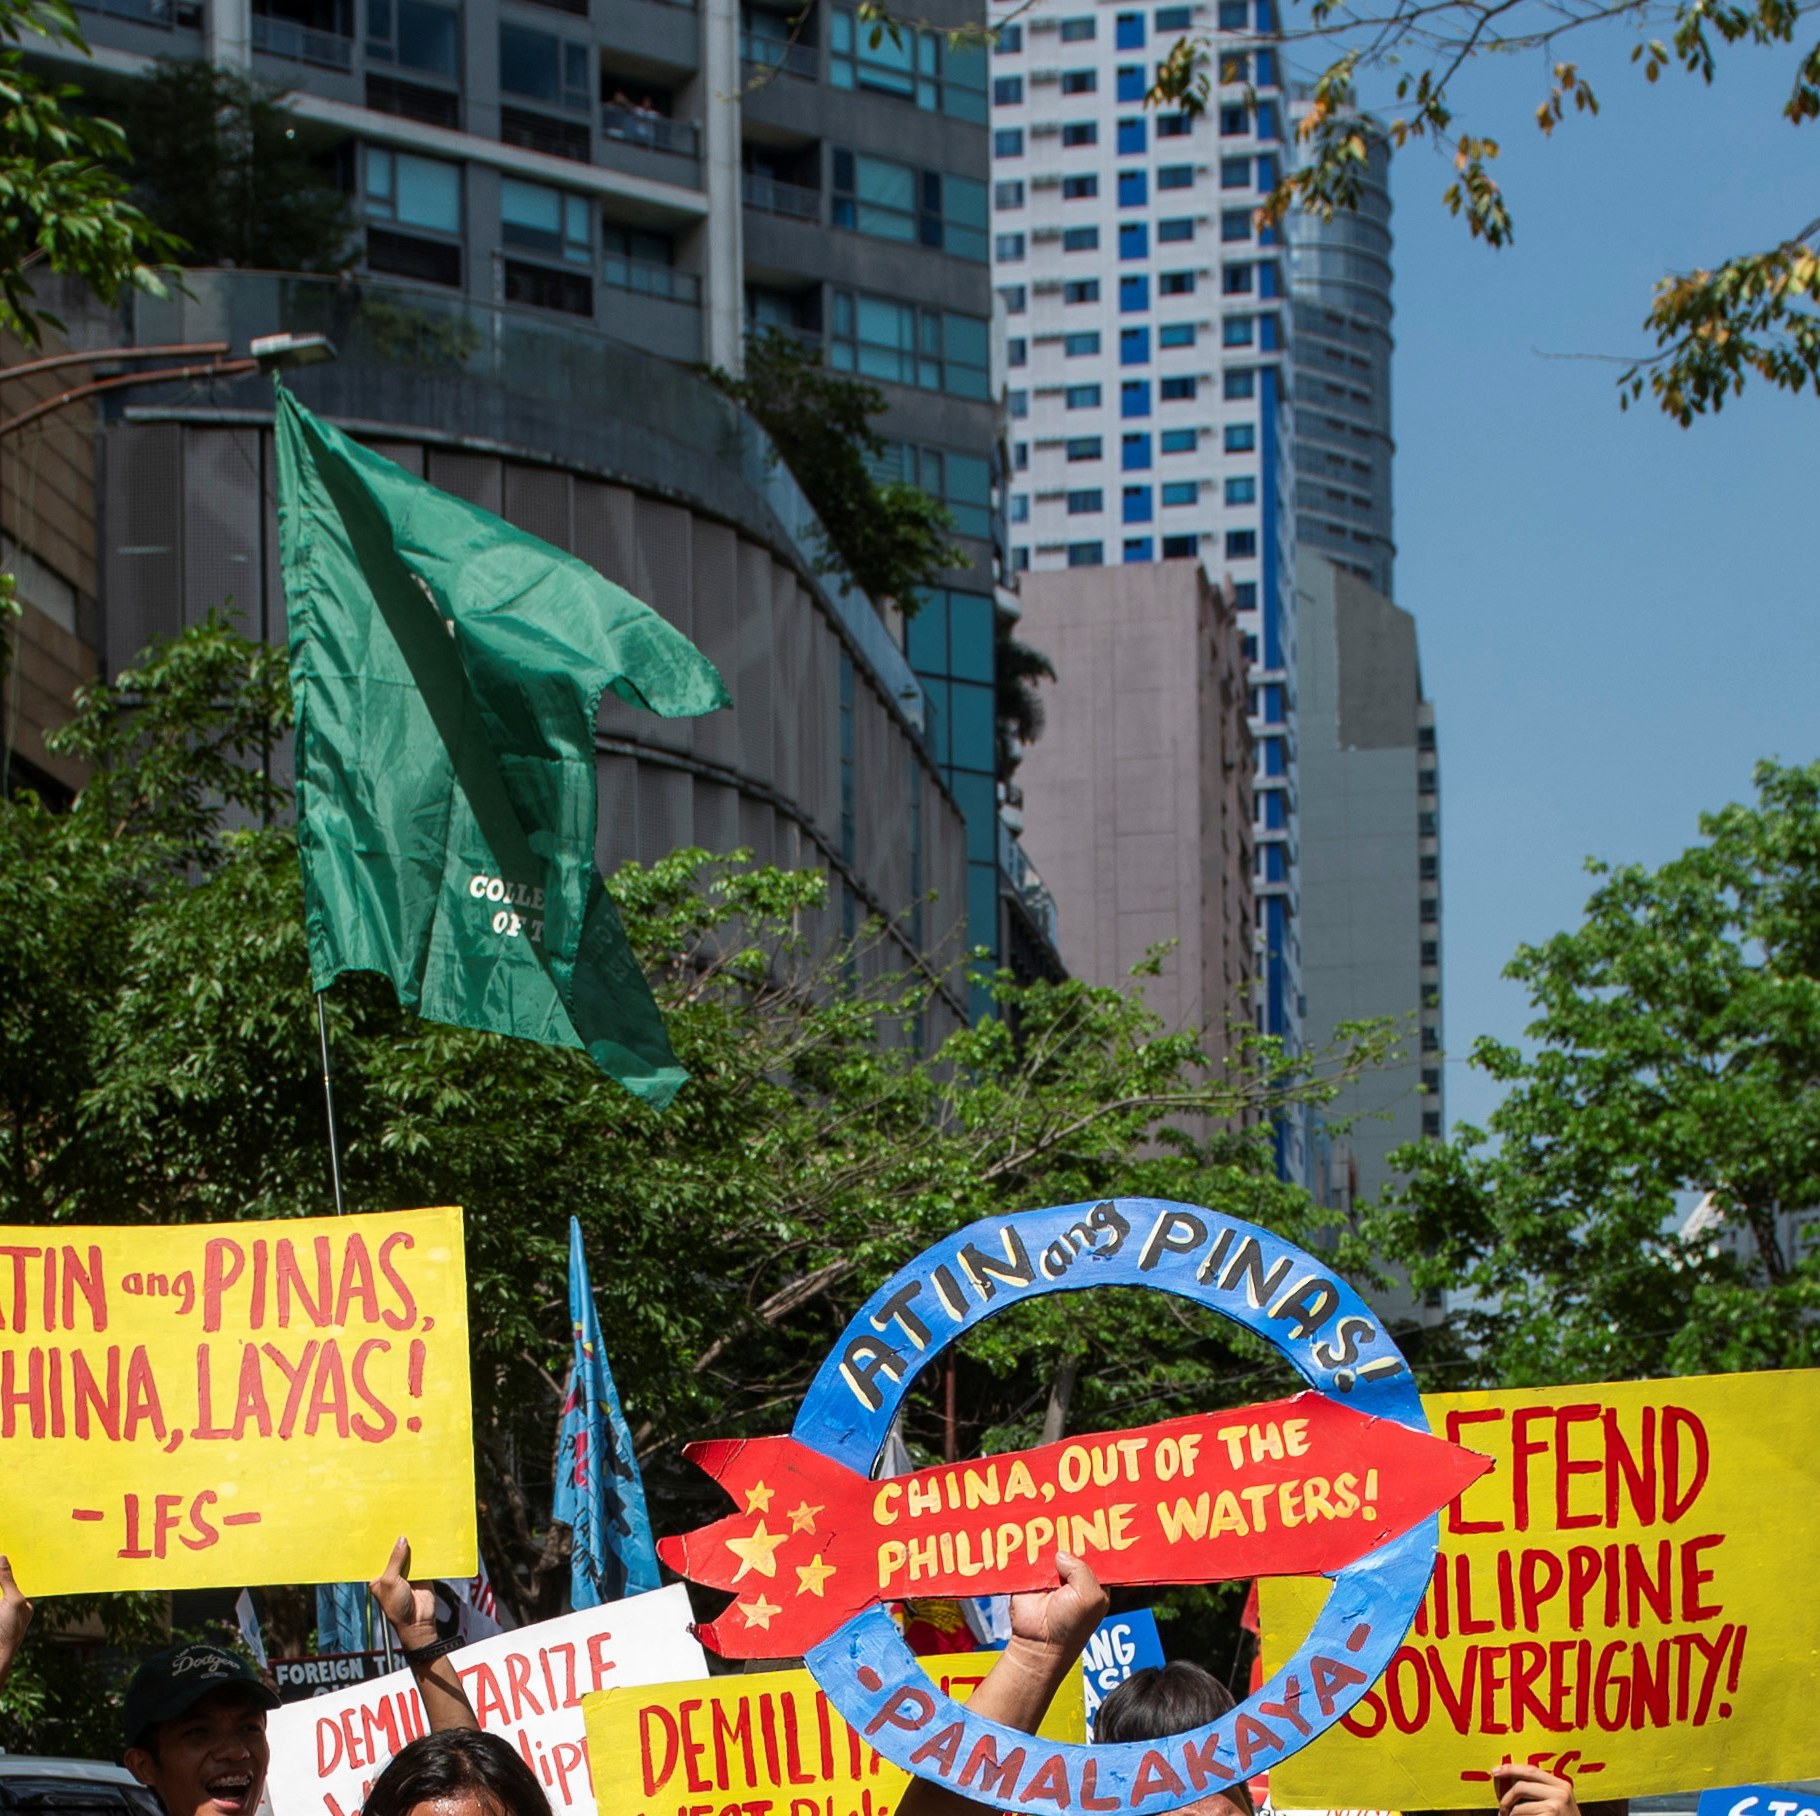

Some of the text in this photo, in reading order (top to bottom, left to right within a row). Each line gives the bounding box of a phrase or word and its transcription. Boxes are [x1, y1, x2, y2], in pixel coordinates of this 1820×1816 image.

[122, 1268, 194, 1316] ang
[203, 1232, 435, 1333] PINAS,
[839, 1199, 1405, 1414] ATIN ang PINAS!
[190, 1338, 427, 1444] LAYAS!
[872, 1417, 1312, 1528] CHINA, OUT OF THE
[1447, 1404, 1710, 1534] EFEND
[877, 1467, 1380, 1589] PHILIPPINE WATERS!
[1407, 1534, 1726, 1640] ILIPPINE
[276, 1656, 365, 1686] FOREIGN
